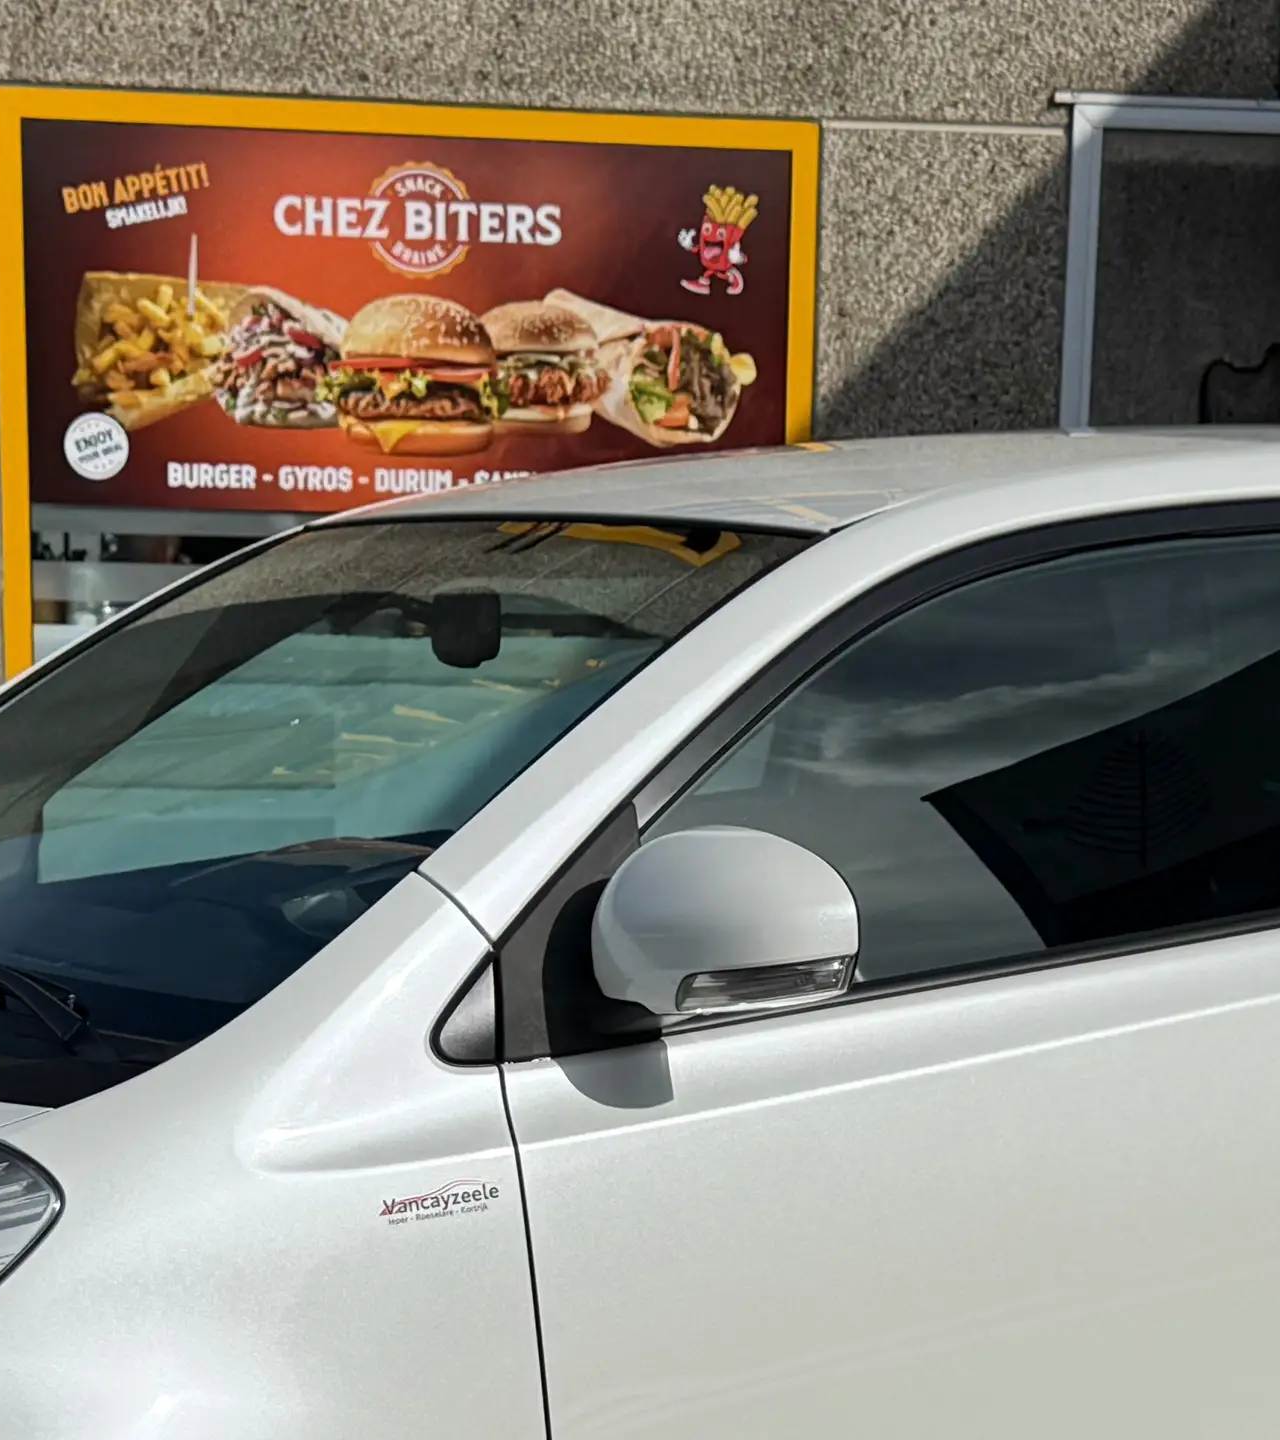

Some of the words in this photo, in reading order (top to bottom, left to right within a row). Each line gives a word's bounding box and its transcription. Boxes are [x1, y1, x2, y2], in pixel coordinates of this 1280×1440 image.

[62, 180, 109, 214] BON
[114, 161, 210, 205] APPÉTIT!
[394, 176, 445, 198] SNACK
[273, 194, 391, 239] CHEZ
[404, 200, 563, 247] BITERS
[167, 461, 257, 490] BURGER
[278, 463, 354, 493] GYROS
[374, 467, 454, 494] DURUM
[382, 1183, 500, 1215] Vancayzeele
